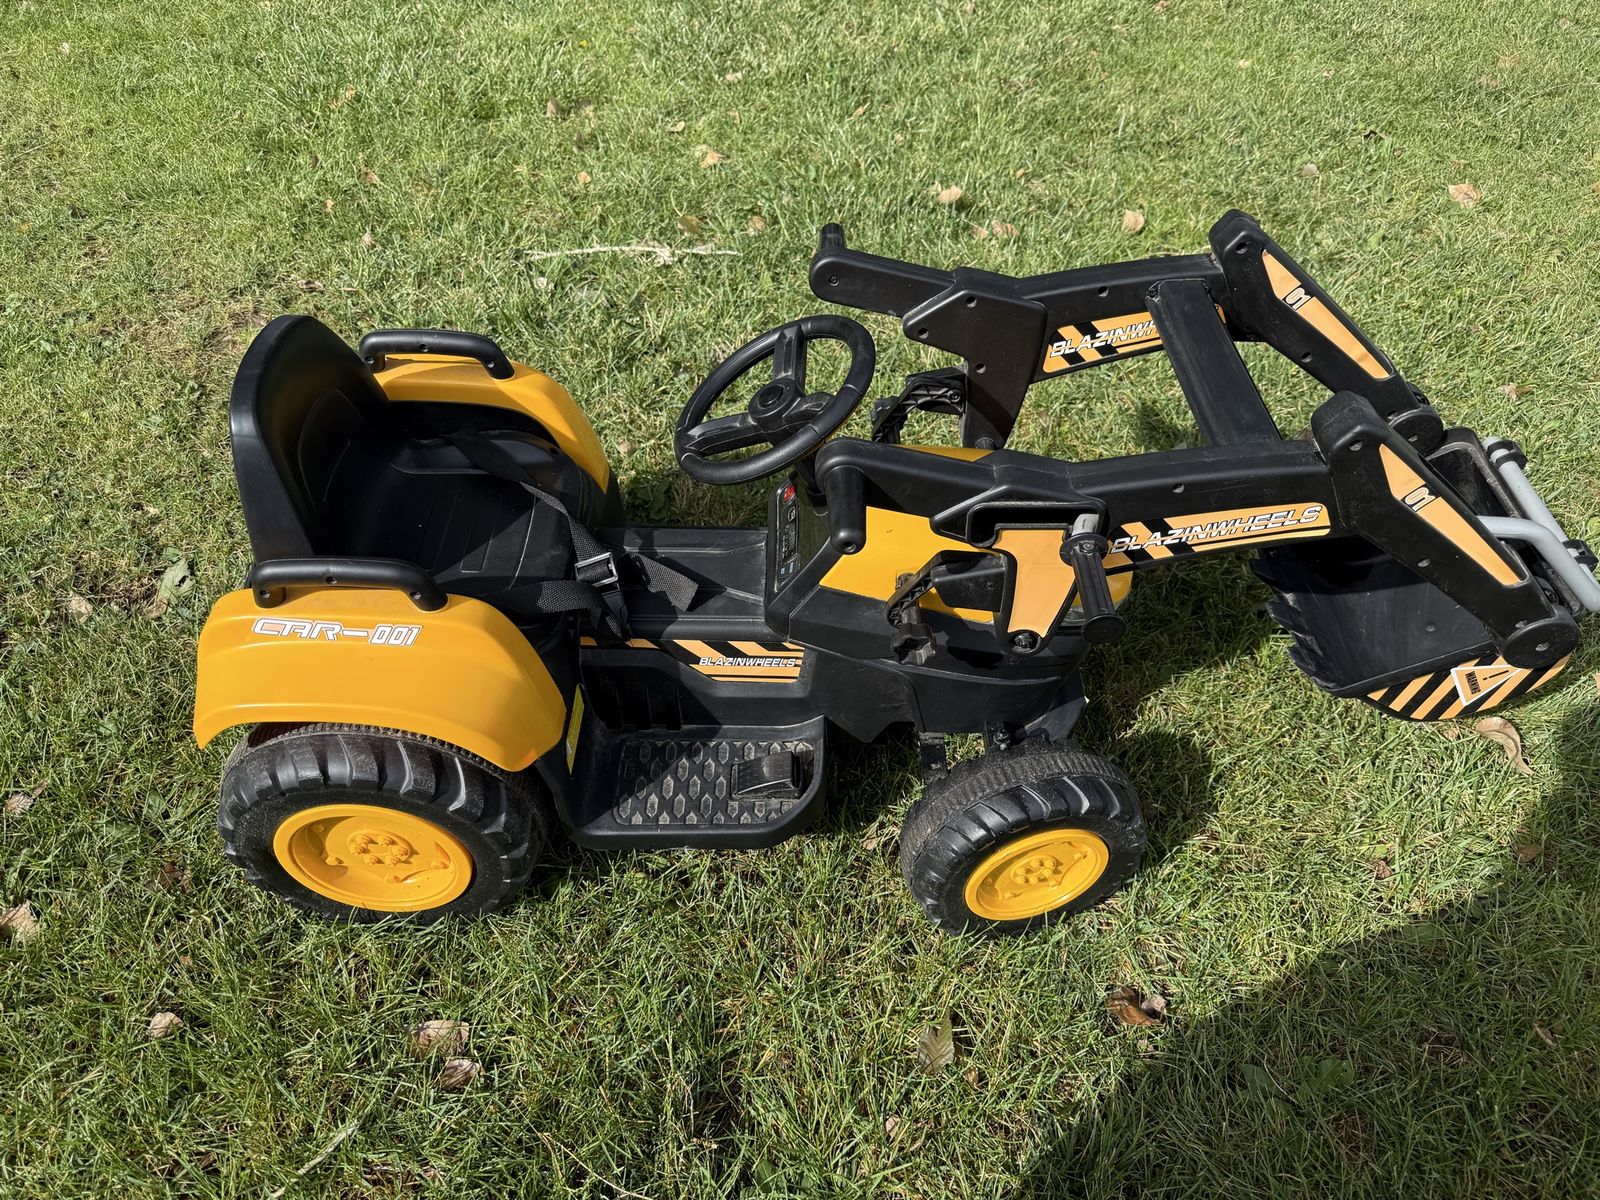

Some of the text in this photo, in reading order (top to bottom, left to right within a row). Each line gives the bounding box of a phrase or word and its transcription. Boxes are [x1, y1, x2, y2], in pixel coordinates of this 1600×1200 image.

[1110, 504, 1323, 554] BLAZINWHEELS
[252, 618, 422, 646] CAR-001
[699, 656, 797, 667] BLAZINWHEELS
